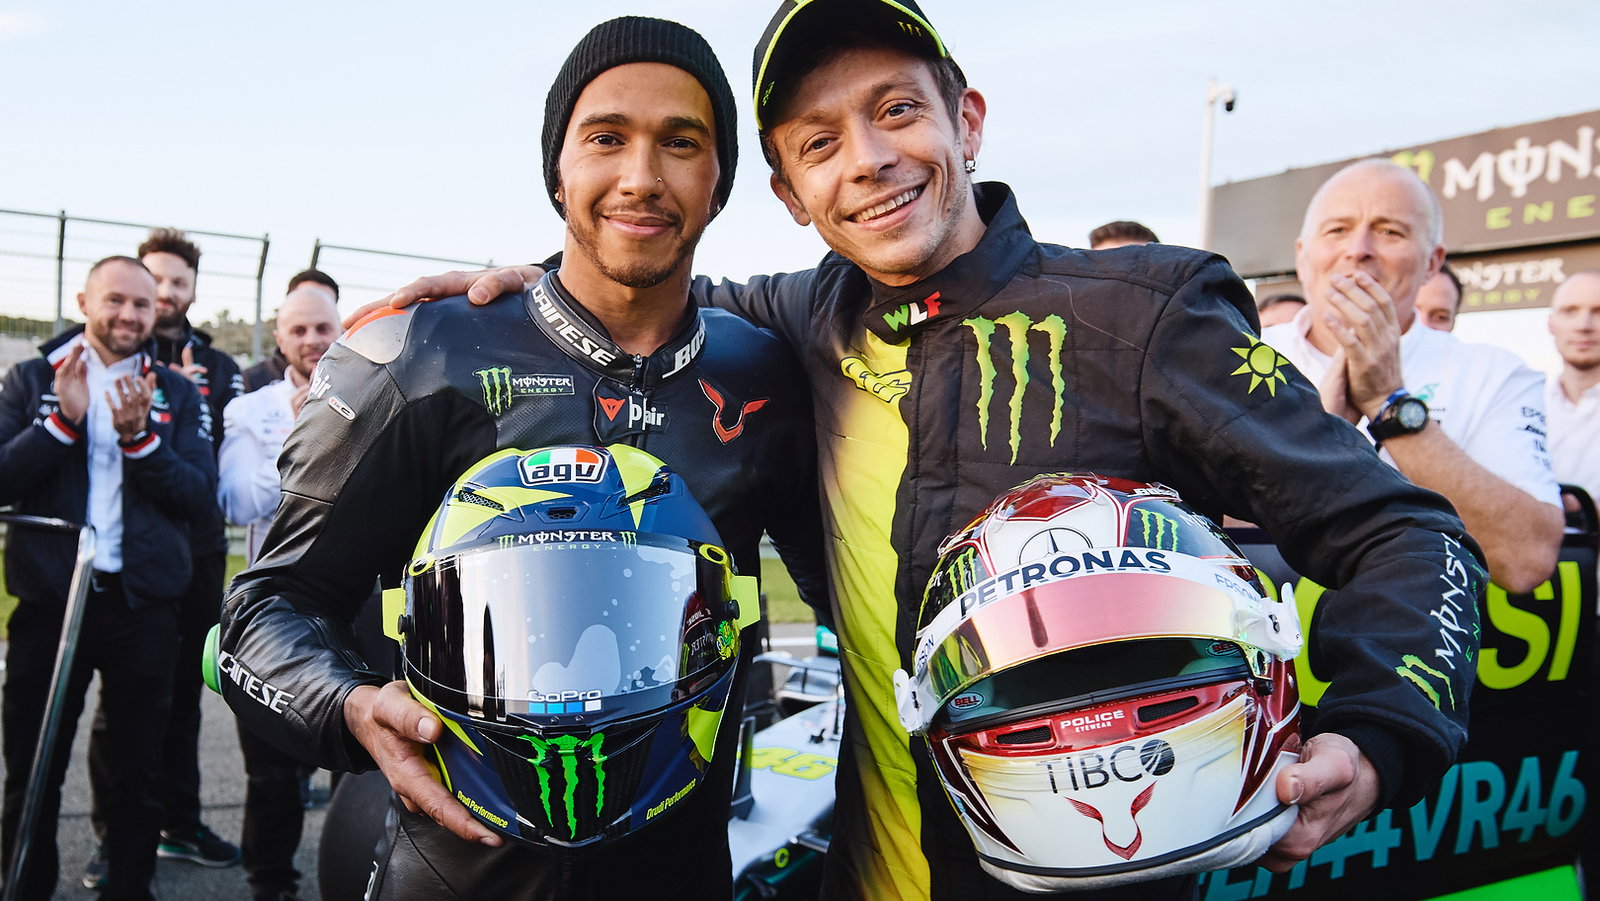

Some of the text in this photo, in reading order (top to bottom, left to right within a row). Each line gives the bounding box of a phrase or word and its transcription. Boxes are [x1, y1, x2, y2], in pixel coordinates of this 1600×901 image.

[1443, 126, 1600, 200] MON
[882, 291, 942, 332] WLF
[532, 284, 617, 367] DAINESE
[512, 376, 572, 387] MONSTER
[531, 463, 597, 482] agv
[518, 529, 617, 545] MONSTER
[532, 543, 602, 552] ENERGY
[961, 549, 1172, 620] PETRONAS
[527, 690, 602, 703] GoPro
[954, 695, 980, 706] BELL
[1060, 710, 1125, 729] POLICE
[1075, 721, 1112, 733] EYEWEAR
[470, 800, 508, 828] Performance
